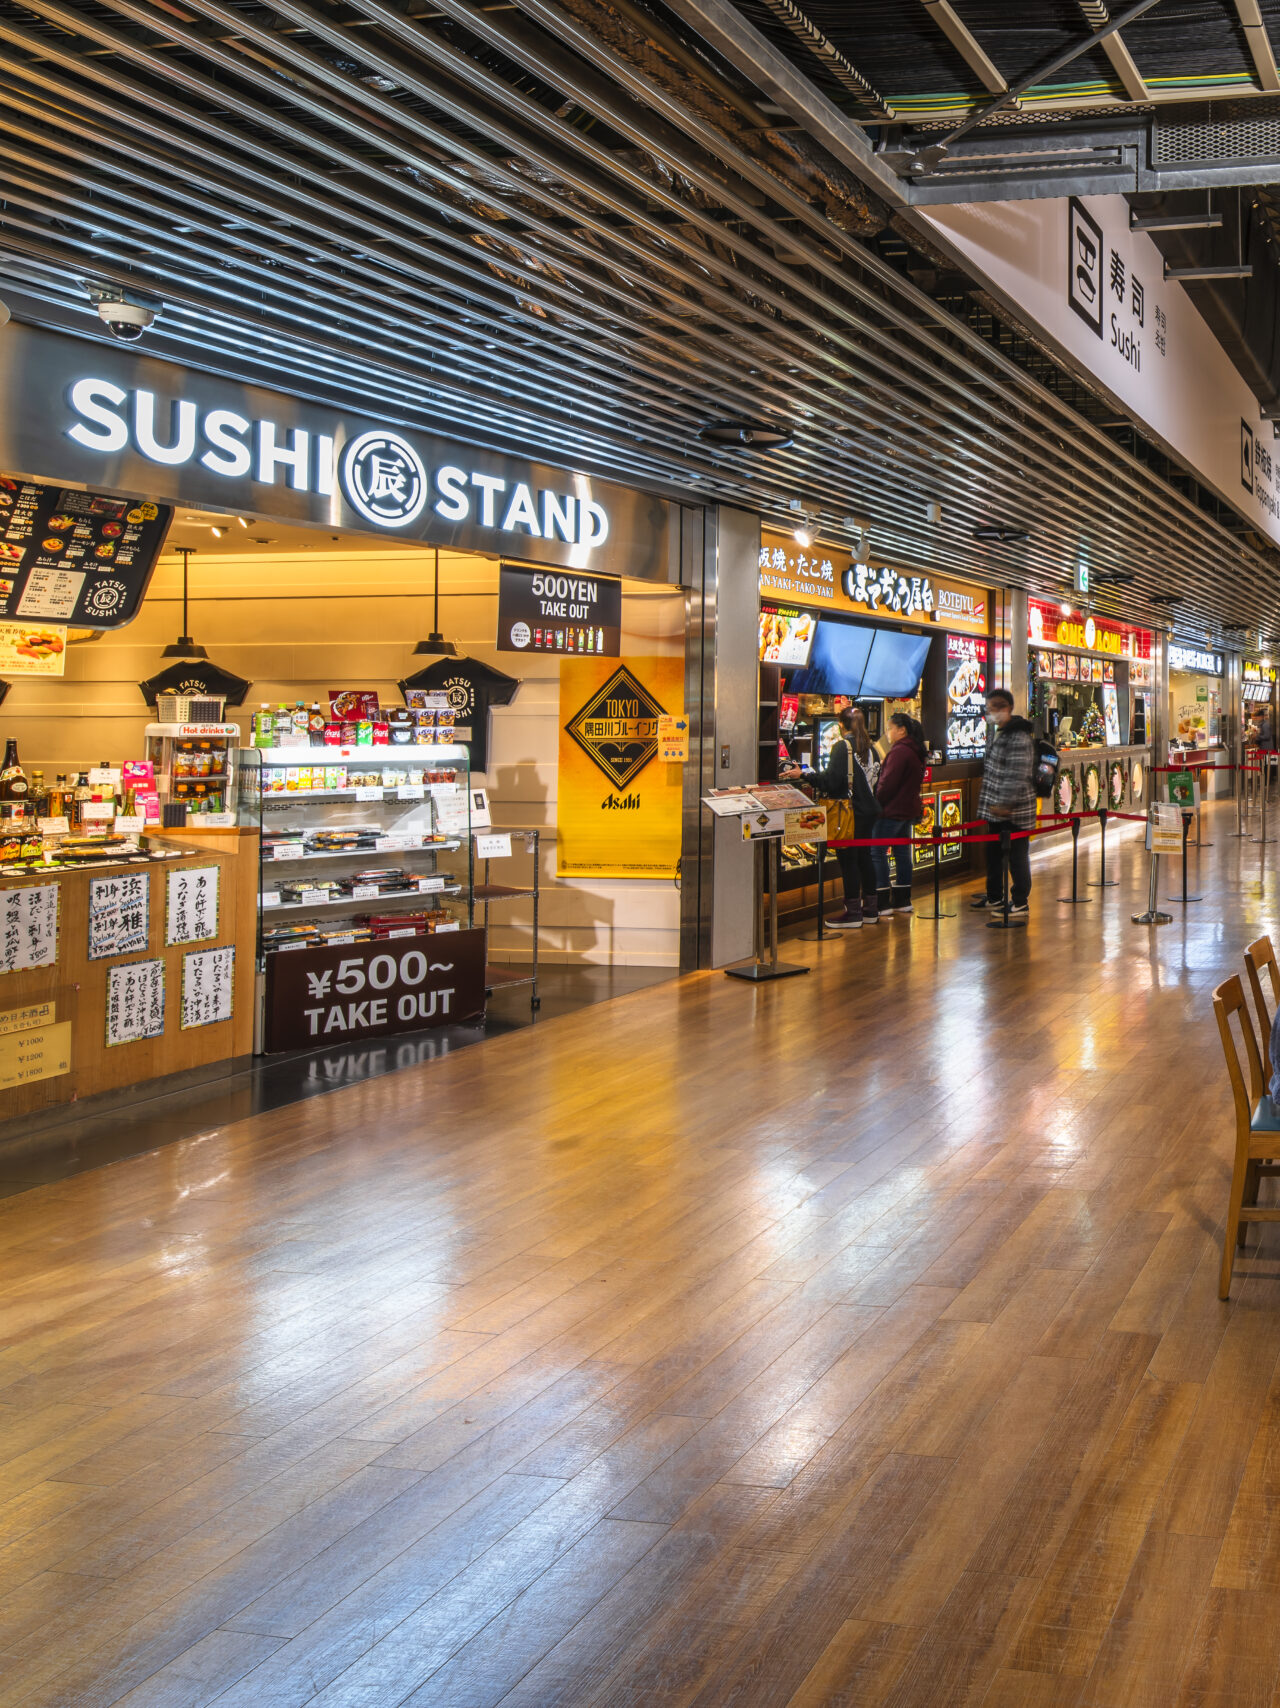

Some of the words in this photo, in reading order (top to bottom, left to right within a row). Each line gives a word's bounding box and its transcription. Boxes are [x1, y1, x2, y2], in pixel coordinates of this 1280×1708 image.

[1110, 247, 1144, 328] 寿司
[1110, 312, 1141, 373] Sushi
[67, 376, 334, 497] SUSHI
[368, 456, 409, 503] 辰
[433, 465, 611, 549] STAND
[94, 579, 127, 591] TATSU
[532, 573, 597, 603] 500YEN
[84, 606, 118, 617] SUSHI
[540, 600, 567, 617] TAKE
[569, 603, 589, 619] OUT
[938, 589, 974, 612] BOTEJYU
[1057, 621, 1083, 650] ONE
[1096, 629, 1121, 654] BOWL
[180, 680, 206, 690] TATSU
[443, 677, 471, 688] TATSU
[606, 699, 639, 718] TOKYO
[200, 726, 224, 734] drinks
[601, 793, 641, 810] Asahi
[304, 998, 388, 1035] TAKE
[397, 988, 455, 1021] OUT
